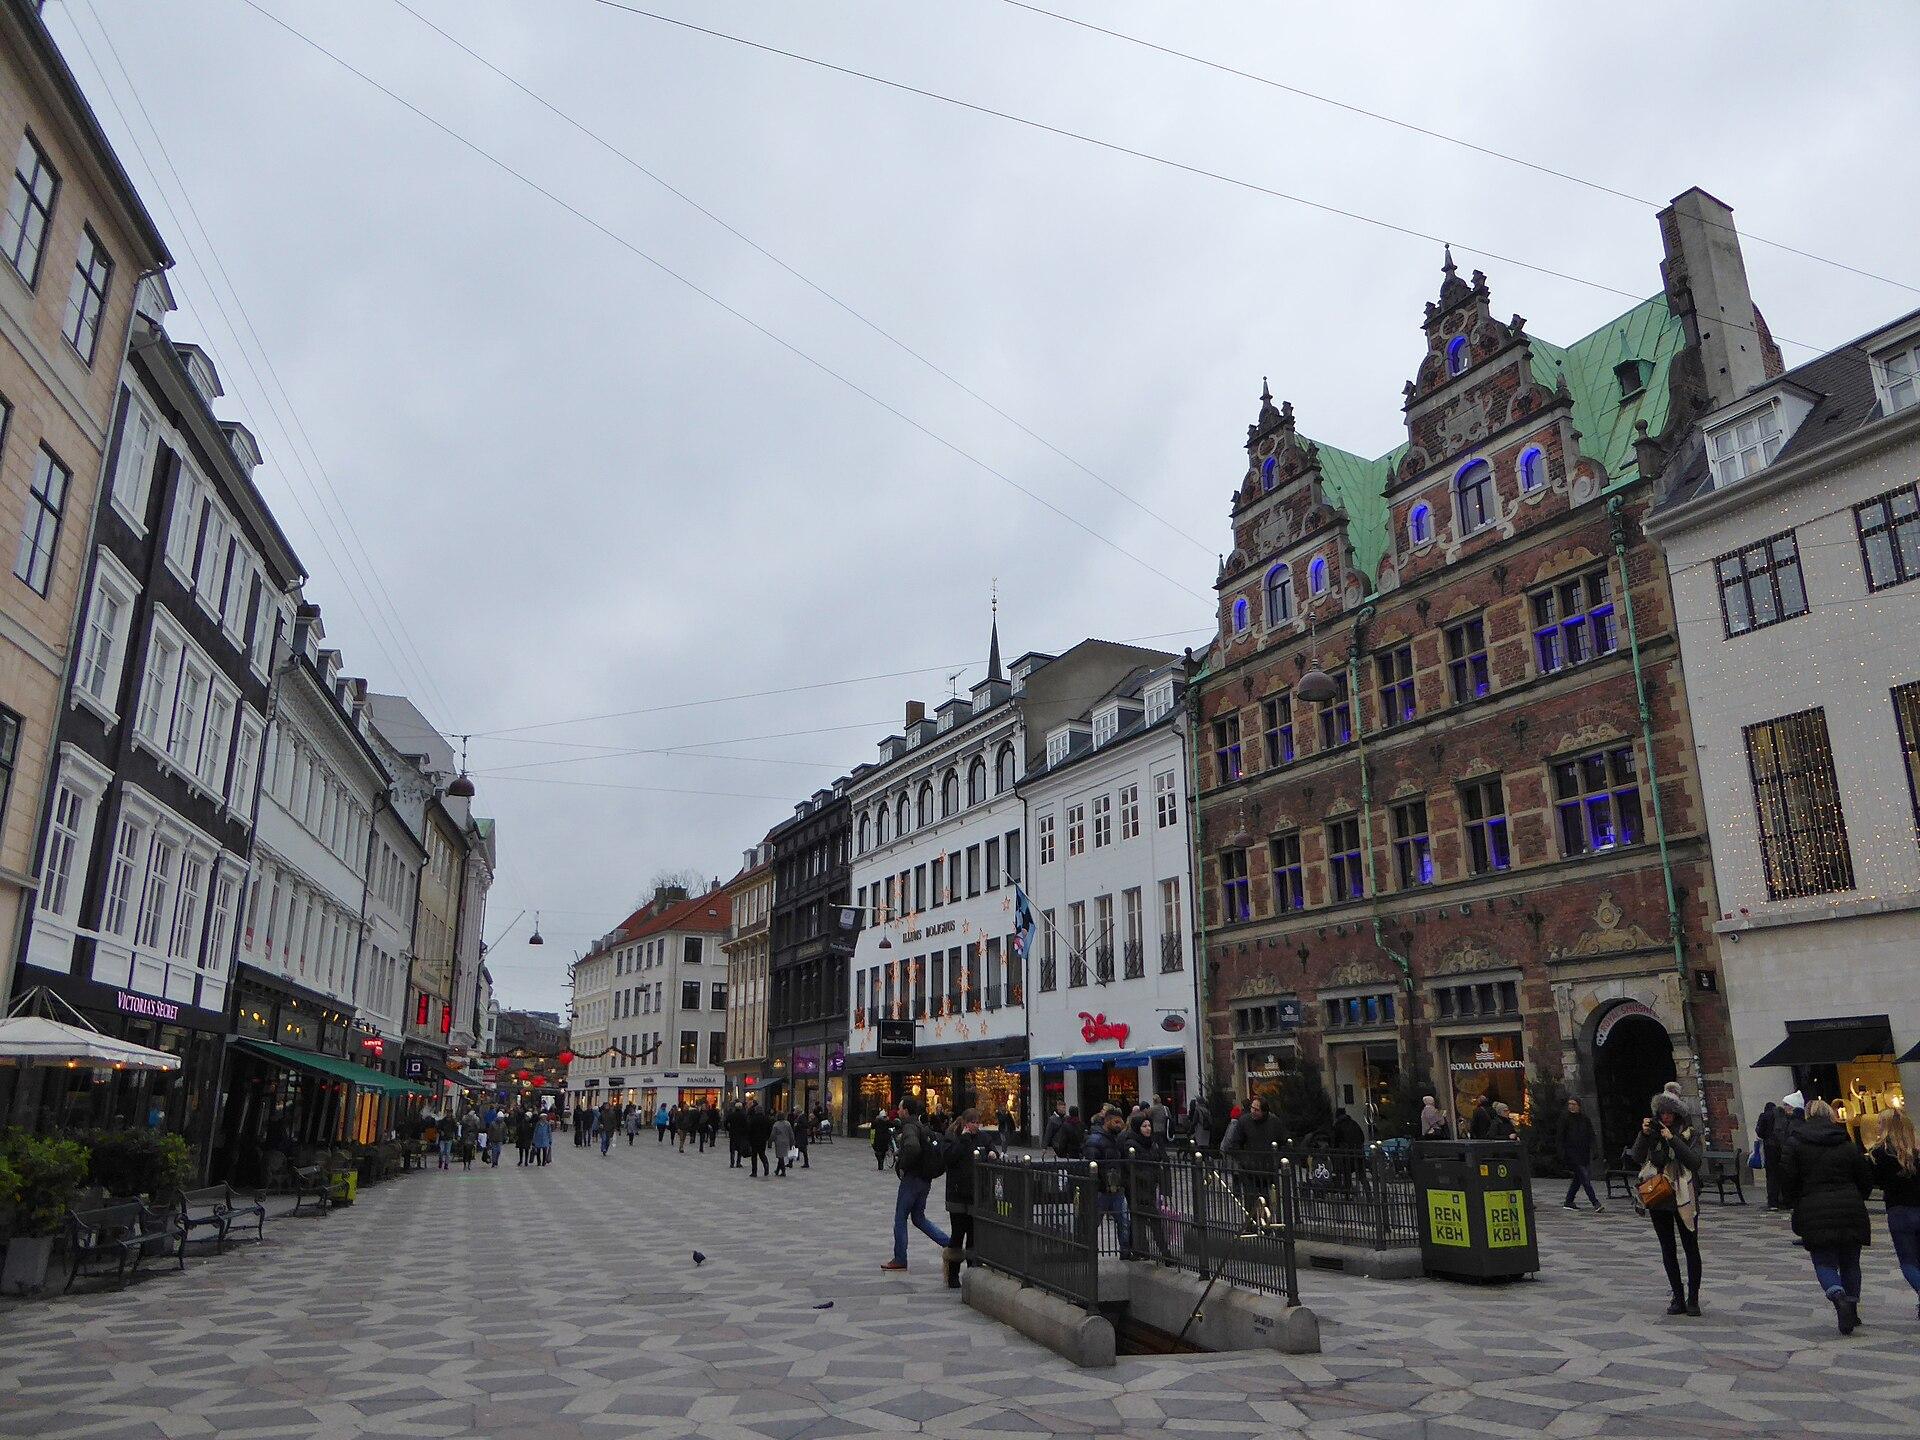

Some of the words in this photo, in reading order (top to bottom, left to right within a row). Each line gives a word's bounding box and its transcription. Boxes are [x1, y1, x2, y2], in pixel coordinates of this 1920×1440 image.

[117, 991, 156, 1015] VICTORIA'S
[156, 1001, 179, 1020] SECRET
[1450, 1061, 1474, 1071] ROYAL
[1473, 1060, 1525, 1070] COPENHAGEN
[686, 1076, 717, 1084] PANDORA
[1434, 1206, 1462, 1222] REN
[1491, 1208, 1519, 1222] REN
[1436, 1225, 1464, 1241] KBH
[1493, 1228, 1521, 1242] KBH
